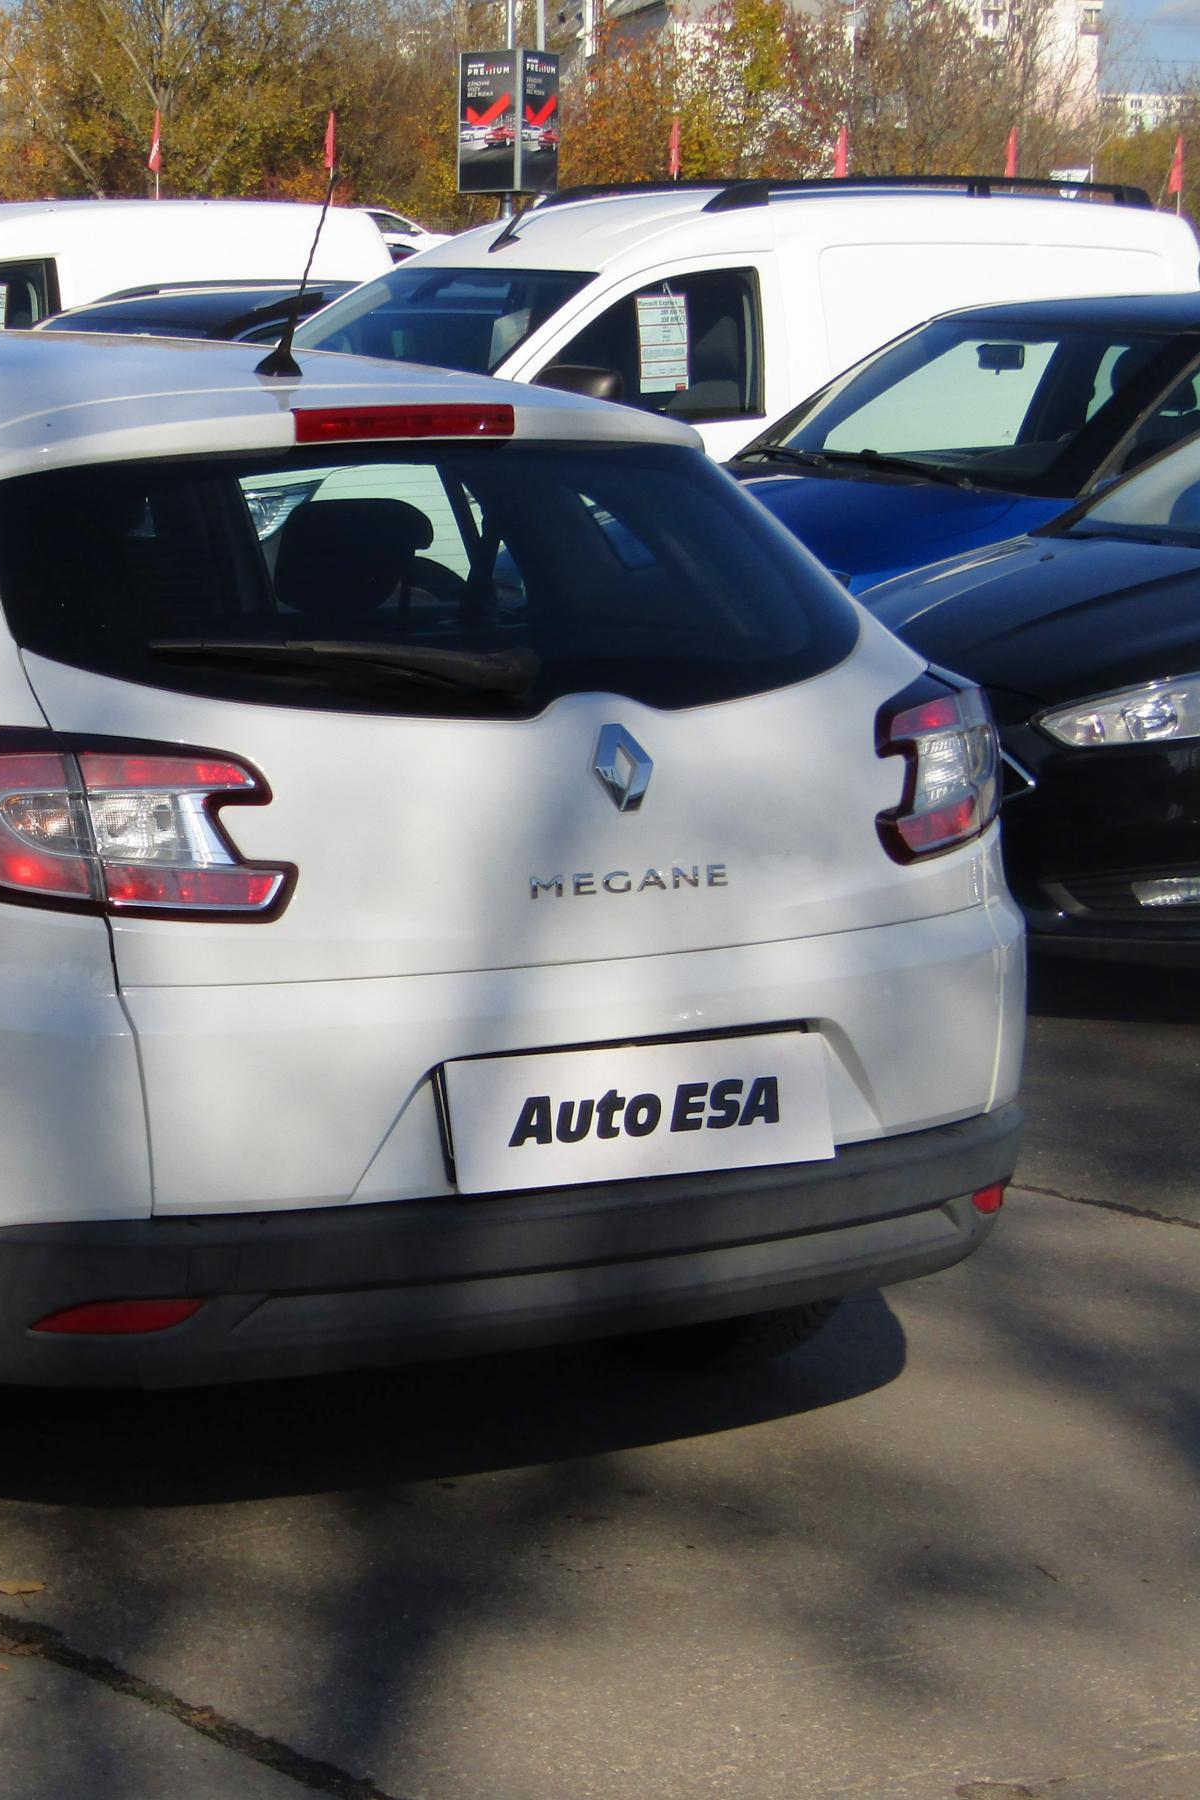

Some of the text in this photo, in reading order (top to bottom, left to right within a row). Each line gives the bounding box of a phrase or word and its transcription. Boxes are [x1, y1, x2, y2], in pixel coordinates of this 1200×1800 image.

[467, 64, 510, 76] PREMIUM
[526, 63, 556, 74] PREMIUM
[529, 863, 729, 900] MEGANE
[508, 1076, 781, 1148] Auto ESA
